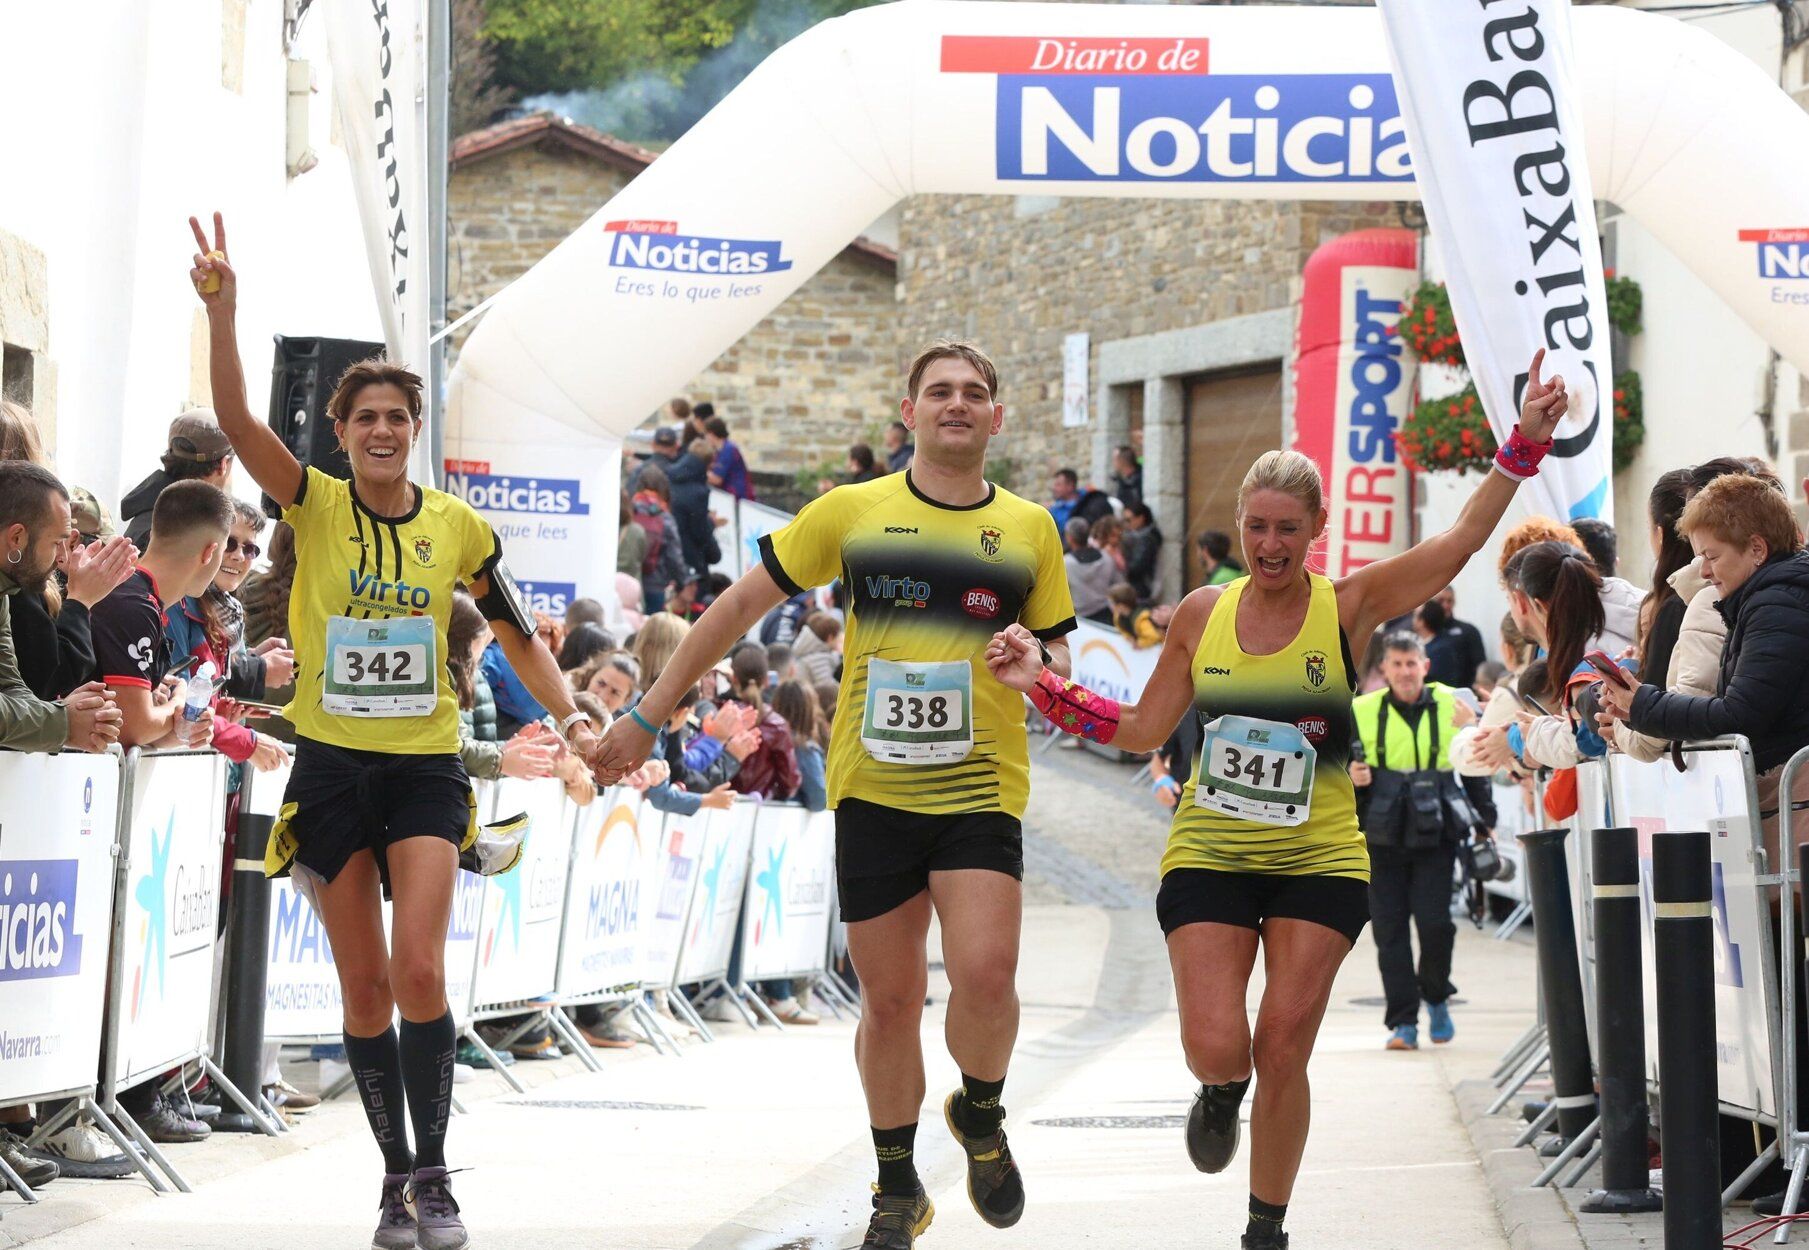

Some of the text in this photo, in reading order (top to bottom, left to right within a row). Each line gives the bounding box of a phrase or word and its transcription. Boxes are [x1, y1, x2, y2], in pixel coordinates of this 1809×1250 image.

[1030, 39, 1200, 71] Diario de
[625, 221, 660, 233] Diario
[1463, 0, 1599, 458] CaixaBa
[615, 234, 768, 273] Noticias
[615, 276, 763, 303] Eres lo que lees
[447, 474, 571, 513] Noticias
[500, 522, 568, 540] que lees
[350, 569, 430, 609] Virto
[866, 575, 931, 600] Virto
[967, 592, 997, 612] BENIS
[350, 599, 407, 615] ultracongelados
[346, 651, 411, 682] 342
[887, 695, 948, 729] 338
[1298, 721, 1325, 735] BENIS
[1223, 747, 1285, 787] 341
[586, 879, 640, 940] MAGNA
[267, 983, 330, 1010] MAGNESITAS
[357, 1068, 395, 1143] kalenji
[429, 1049, 456, 1136] kalenji
